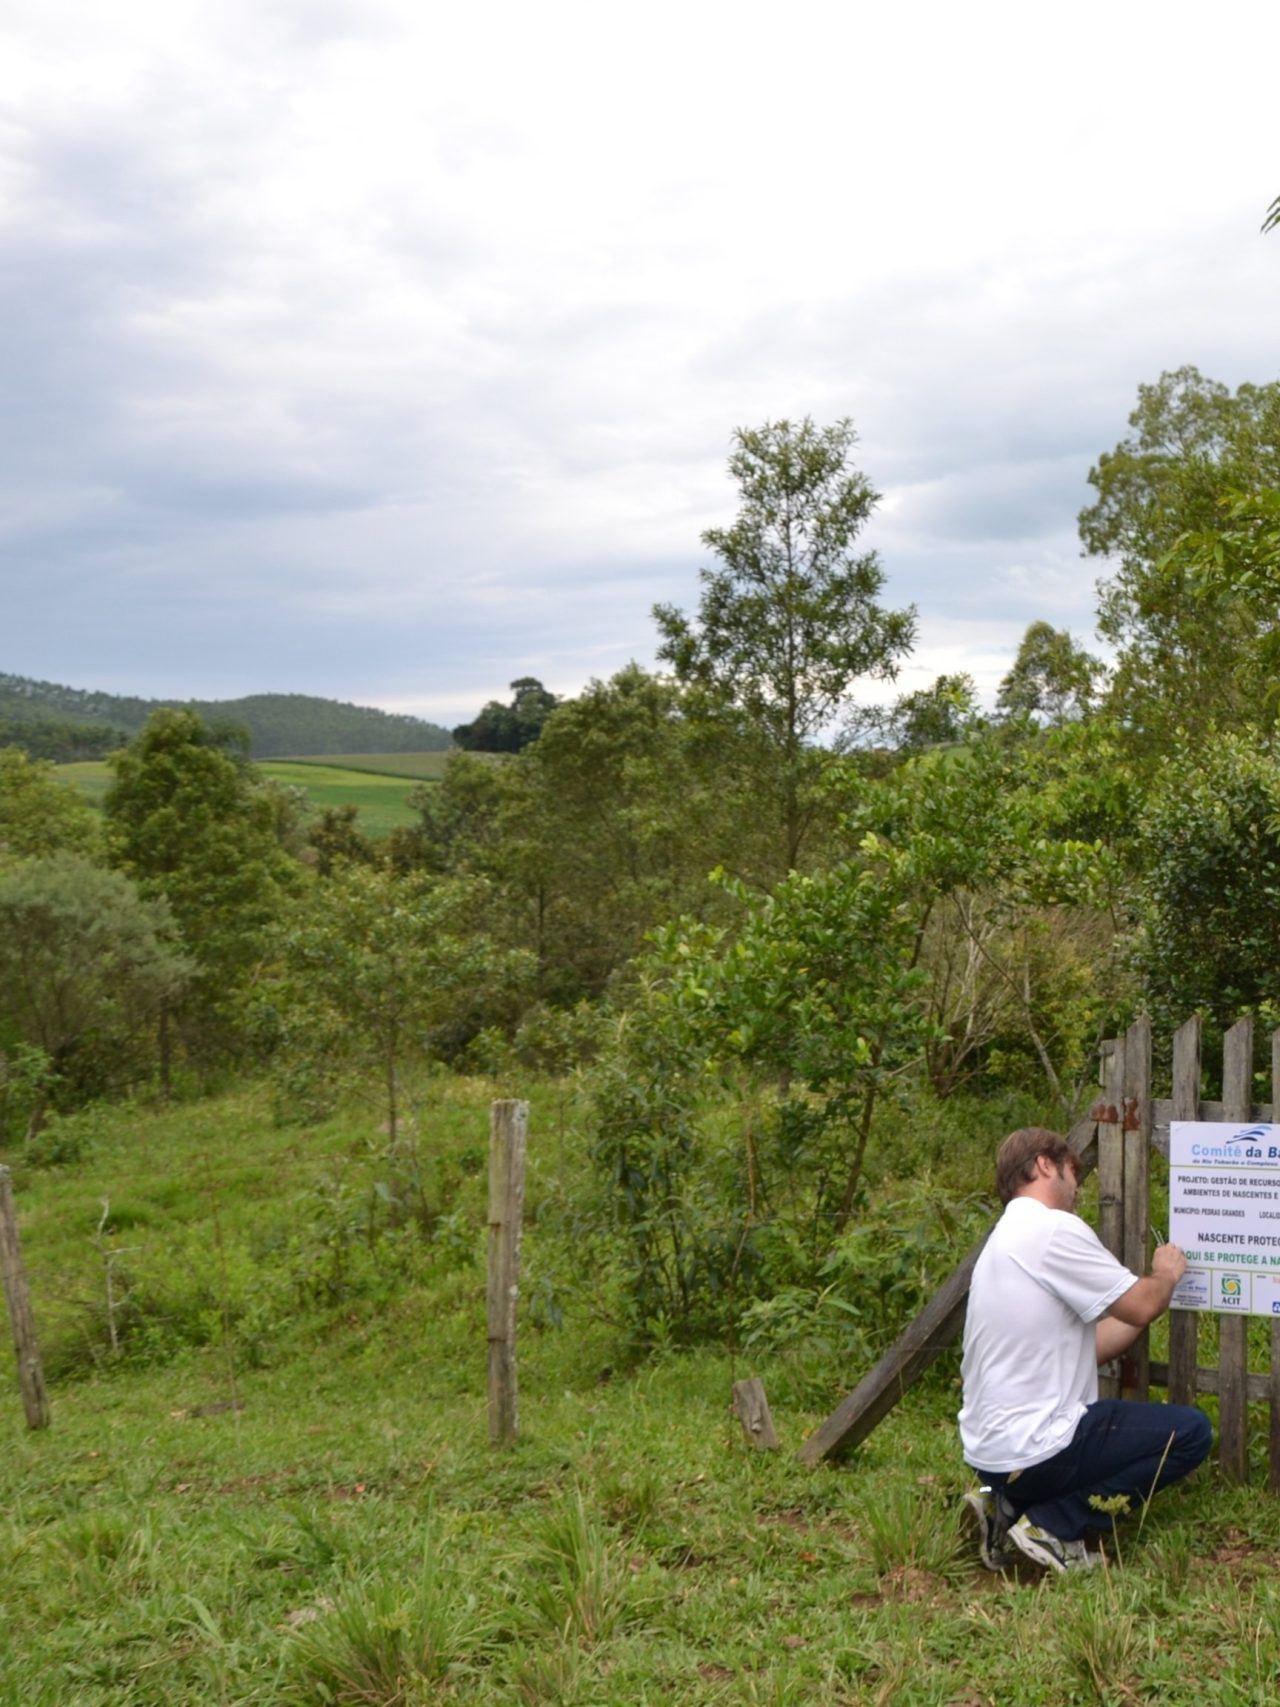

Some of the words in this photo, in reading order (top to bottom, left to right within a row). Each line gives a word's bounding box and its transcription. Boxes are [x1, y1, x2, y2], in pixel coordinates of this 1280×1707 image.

[1192, 1144, 1242, 1157] Comitê
[1246, 1147, 1262, 1158] da
[1211, 1176, 1237, 1185] GESTÃO
[1232, 1191, 1272, 1199] NASCENTES
[1222, 1209, 1245, 1217] GRANDES
[1198, 1232, 1245, 1244] NASCENTE
[1184, 1251, 1200, 1260] QUI
[1204, 1252, 1214, 1261] SE
[1218, 1253, 1258, 1264] PROTEGE
[1262, 1256, 1267, 1264] A
[1222, 1297, 1240, 1305] ACIT
